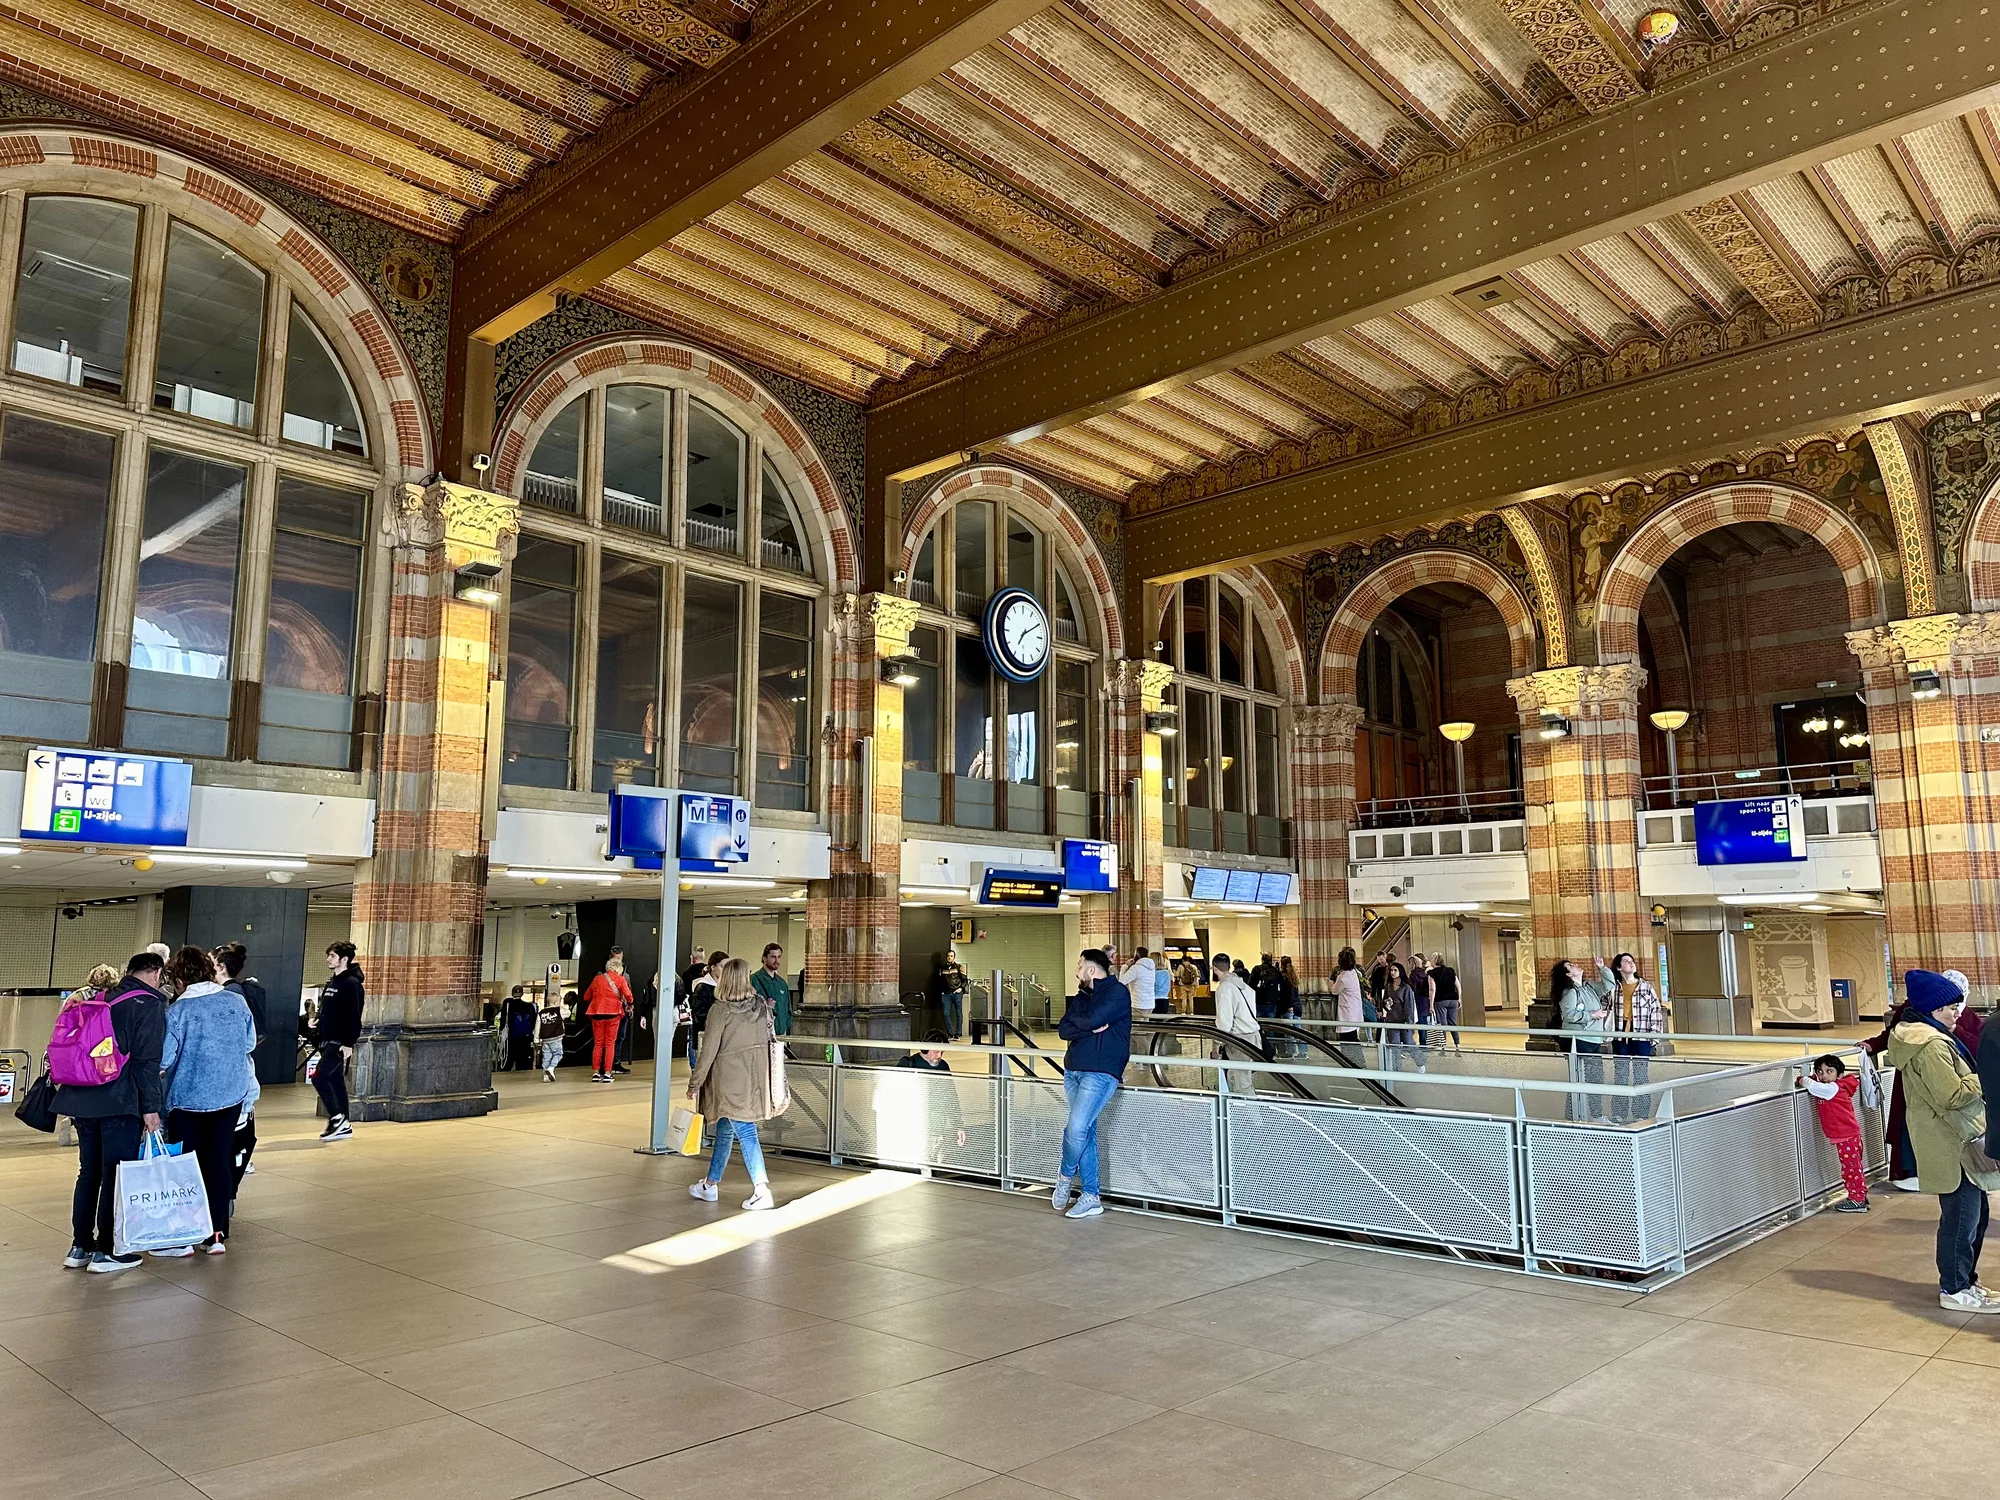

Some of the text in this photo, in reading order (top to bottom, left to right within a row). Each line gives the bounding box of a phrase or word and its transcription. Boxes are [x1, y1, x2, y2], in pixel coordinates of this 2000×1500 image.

[90, 797, 107, 806] WC
[84, 810, 122, 822] IJ-zijde
[691, 807, 704, 821] M
[129, 1187, 197, 1205] PRIMARK
